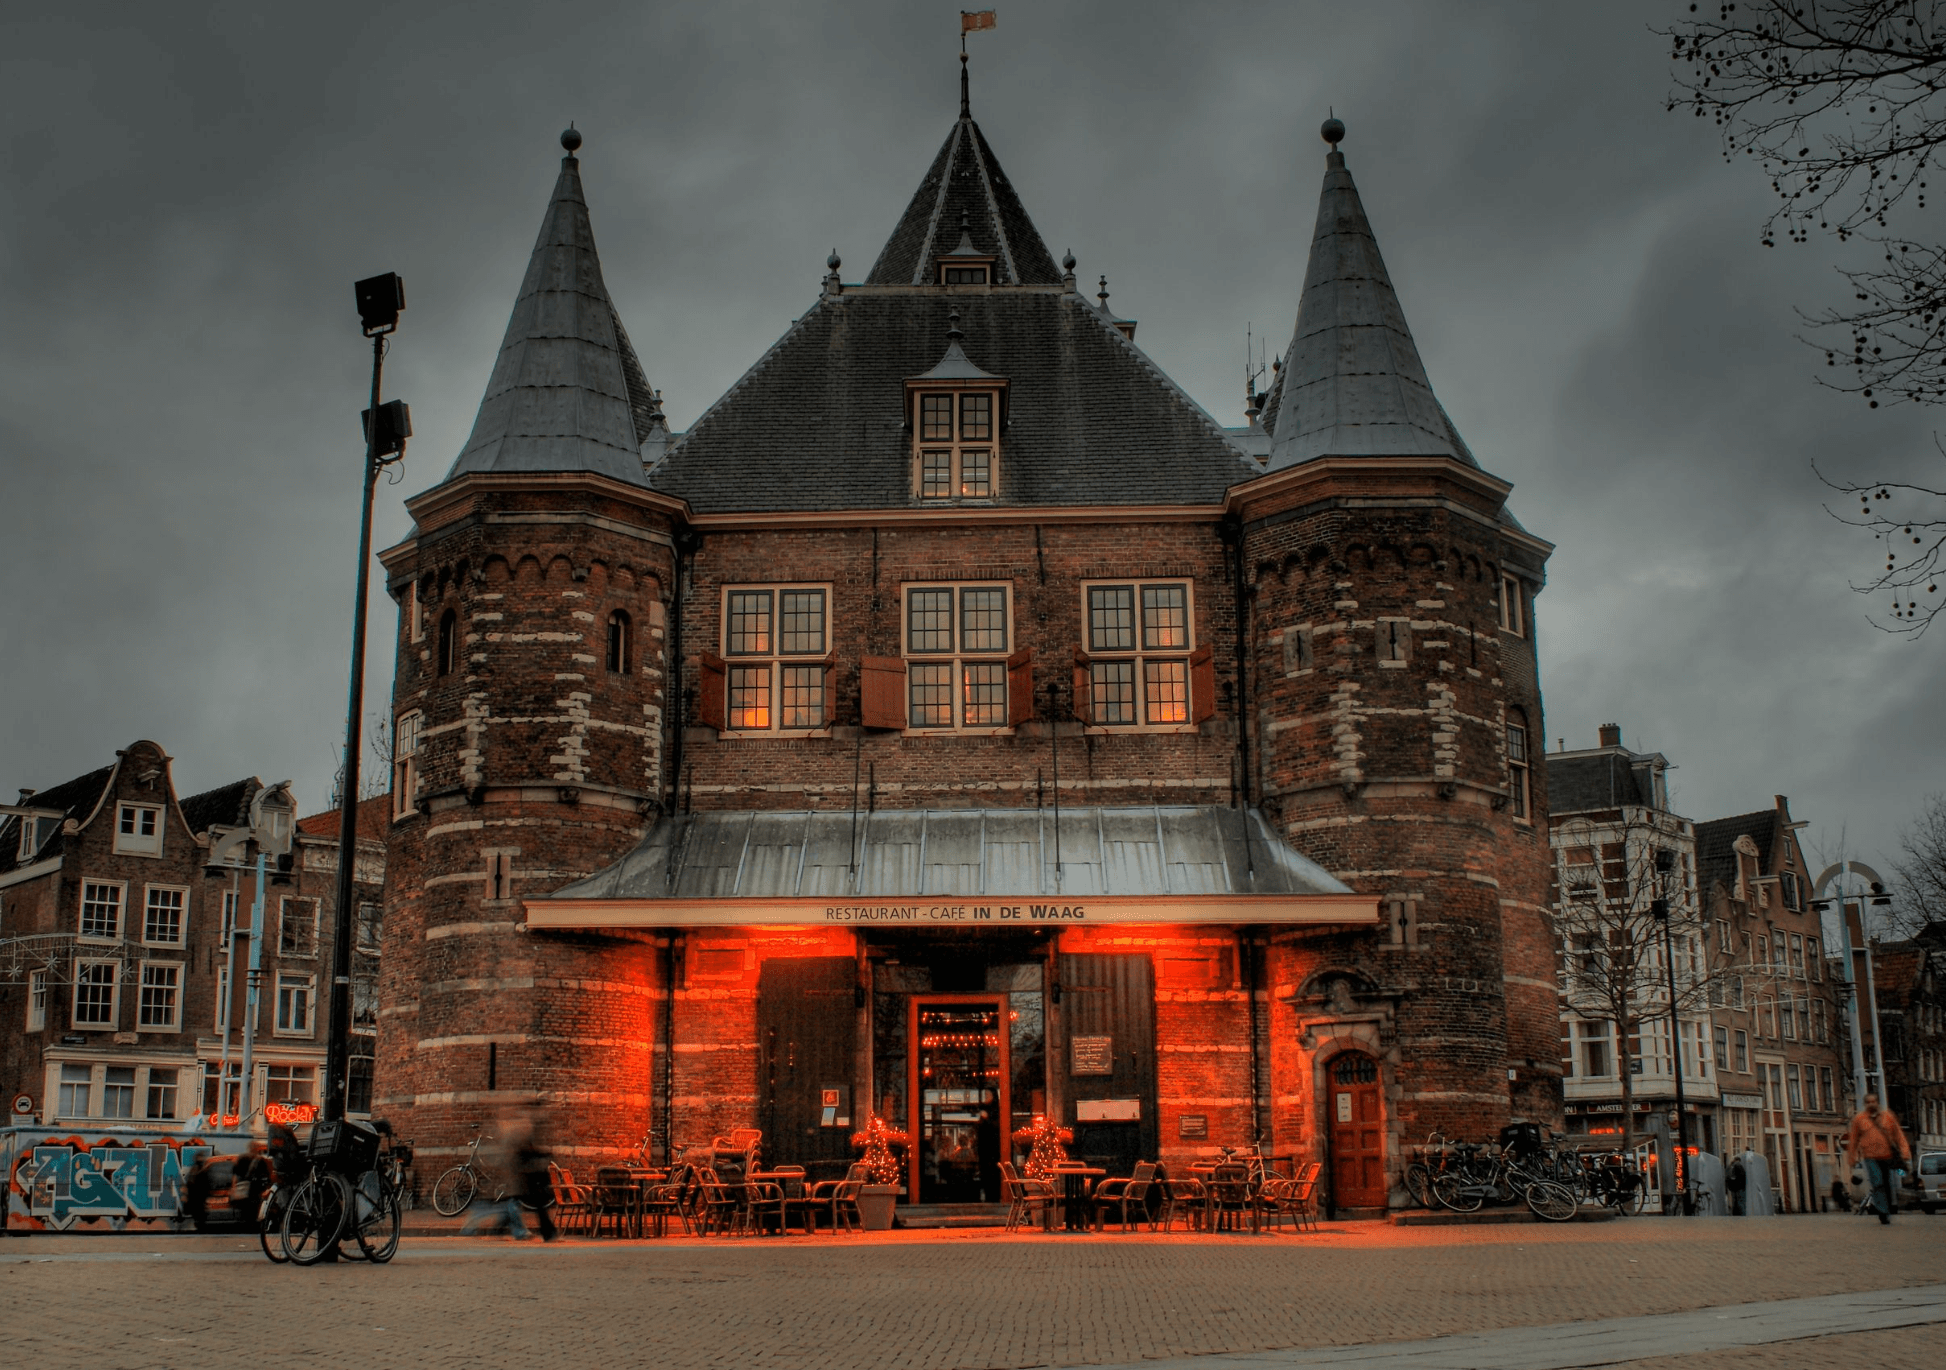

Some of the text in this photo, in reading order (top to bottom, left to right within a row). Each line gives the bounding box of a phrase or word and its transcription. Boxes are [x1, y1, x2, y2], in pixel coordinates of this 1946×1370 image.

[826, 907, 920, 920] RESTAURANT
[973, 907, 991, 919] IN
[1000, 906, 1021, 919] DE
[1029, 904, 1085, 919] WAAG
